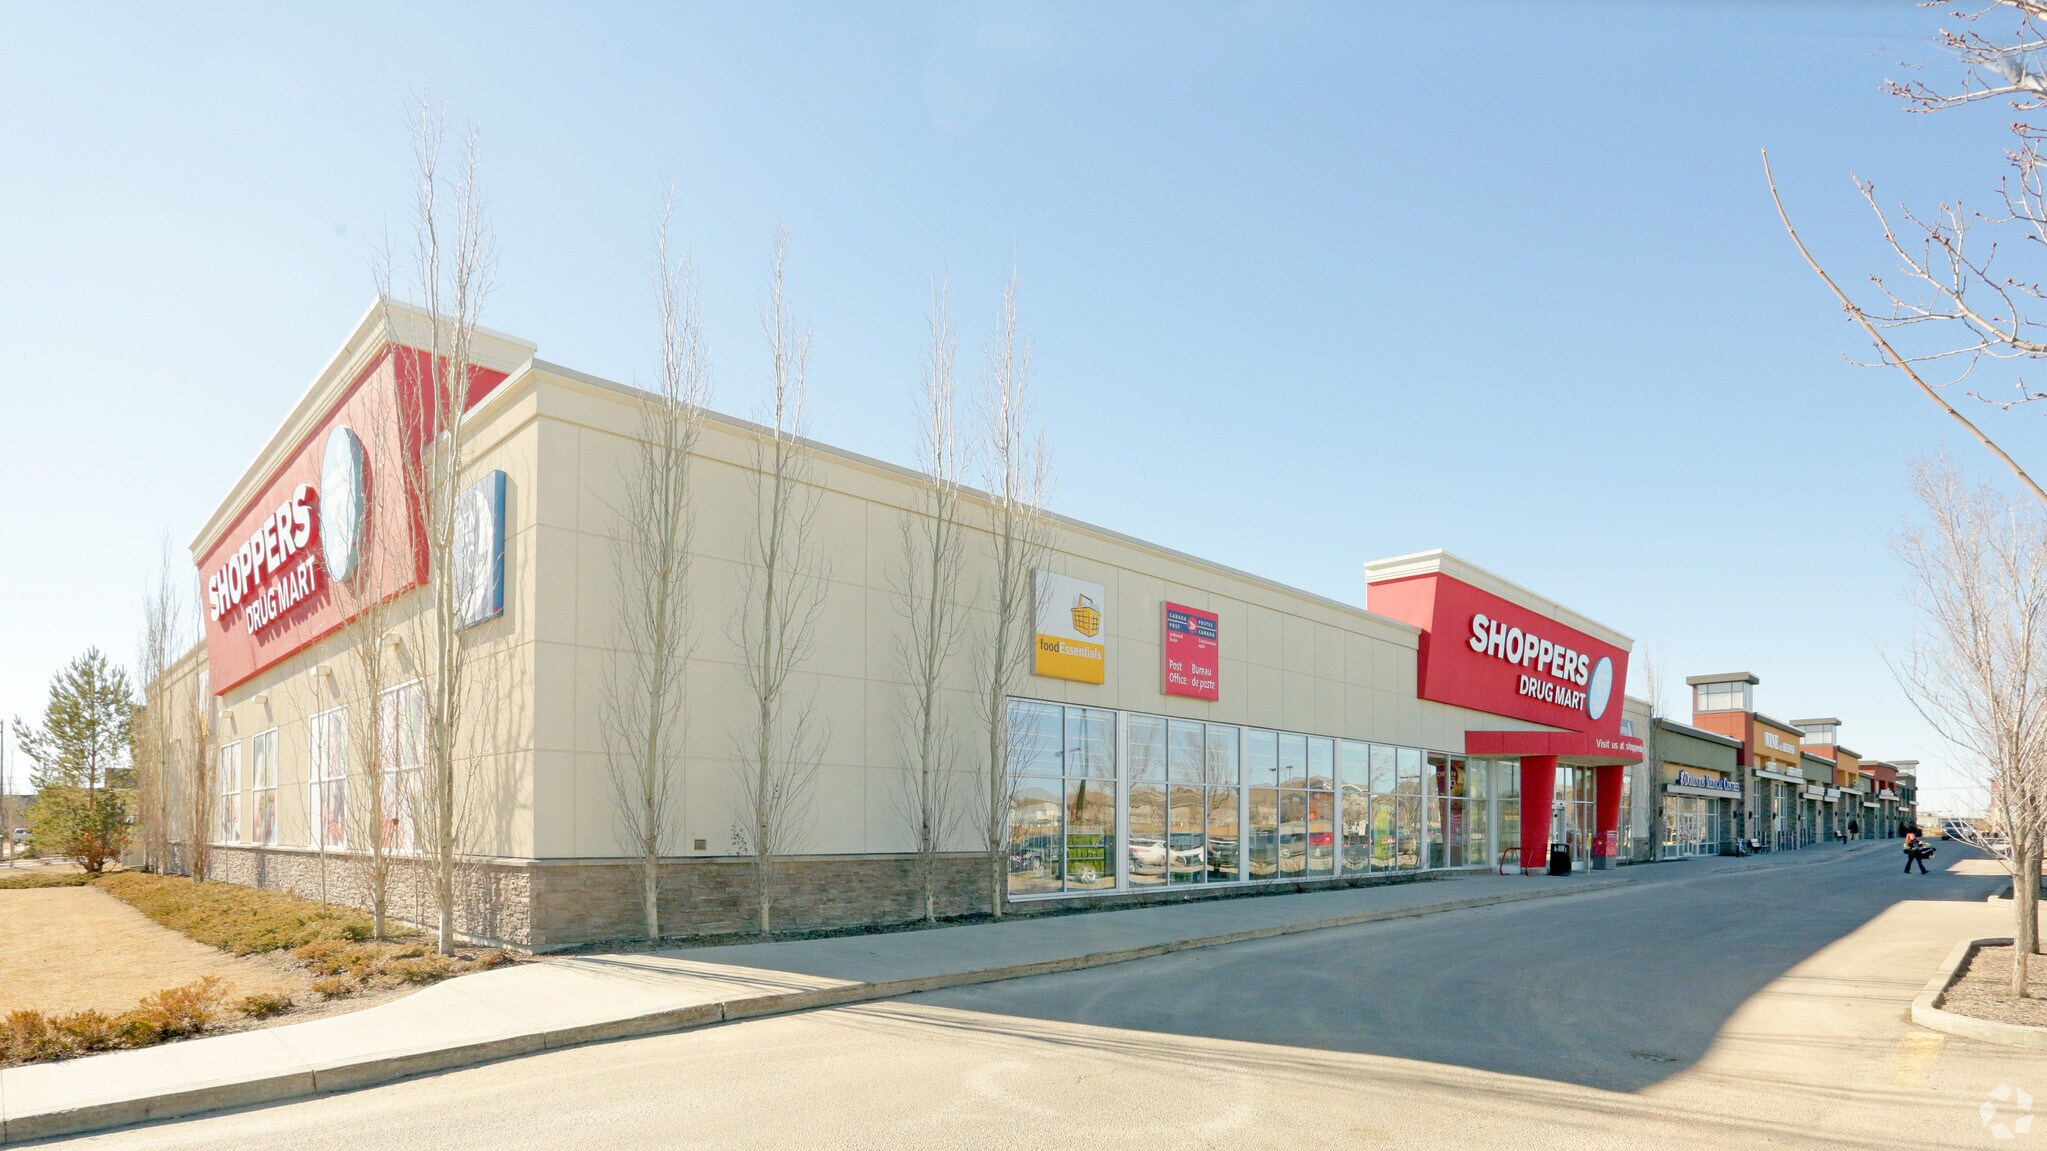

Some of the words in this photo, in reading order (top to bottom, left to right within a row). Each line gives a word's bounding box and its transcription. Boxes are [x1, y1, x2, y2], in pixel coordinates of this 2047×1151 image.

[208, 483, 311, 622] SHOPPERS
[245, 587, 278, 635] DRUG
[277, 555, 315, 613] MART
[1169, 613, 1187, 621] CANADA
[1169, 622, 1181, 630] POST
[1198, 629, 1216, 638] CANADA
[1040, 638, 1102, 660] foodEssentials
[1469, 613, 1590, 686] SHOPPERS
[1169, 659, 1182, 671] Post
[1191, 664, 1211, 676] Bureau
[1169, 672, 1187, 685] Office
[1191, 676, 1199, 687] de
[1199, 679, 1216, 692] poste
[1519, 674, 1554, 702] DRUG
[1554, 685, 1586, 710] MART
[1596, 738, 1610, 749] Visit
[1611, 742, 1619, 750] us
[1619, 741, 1625, 750] at
